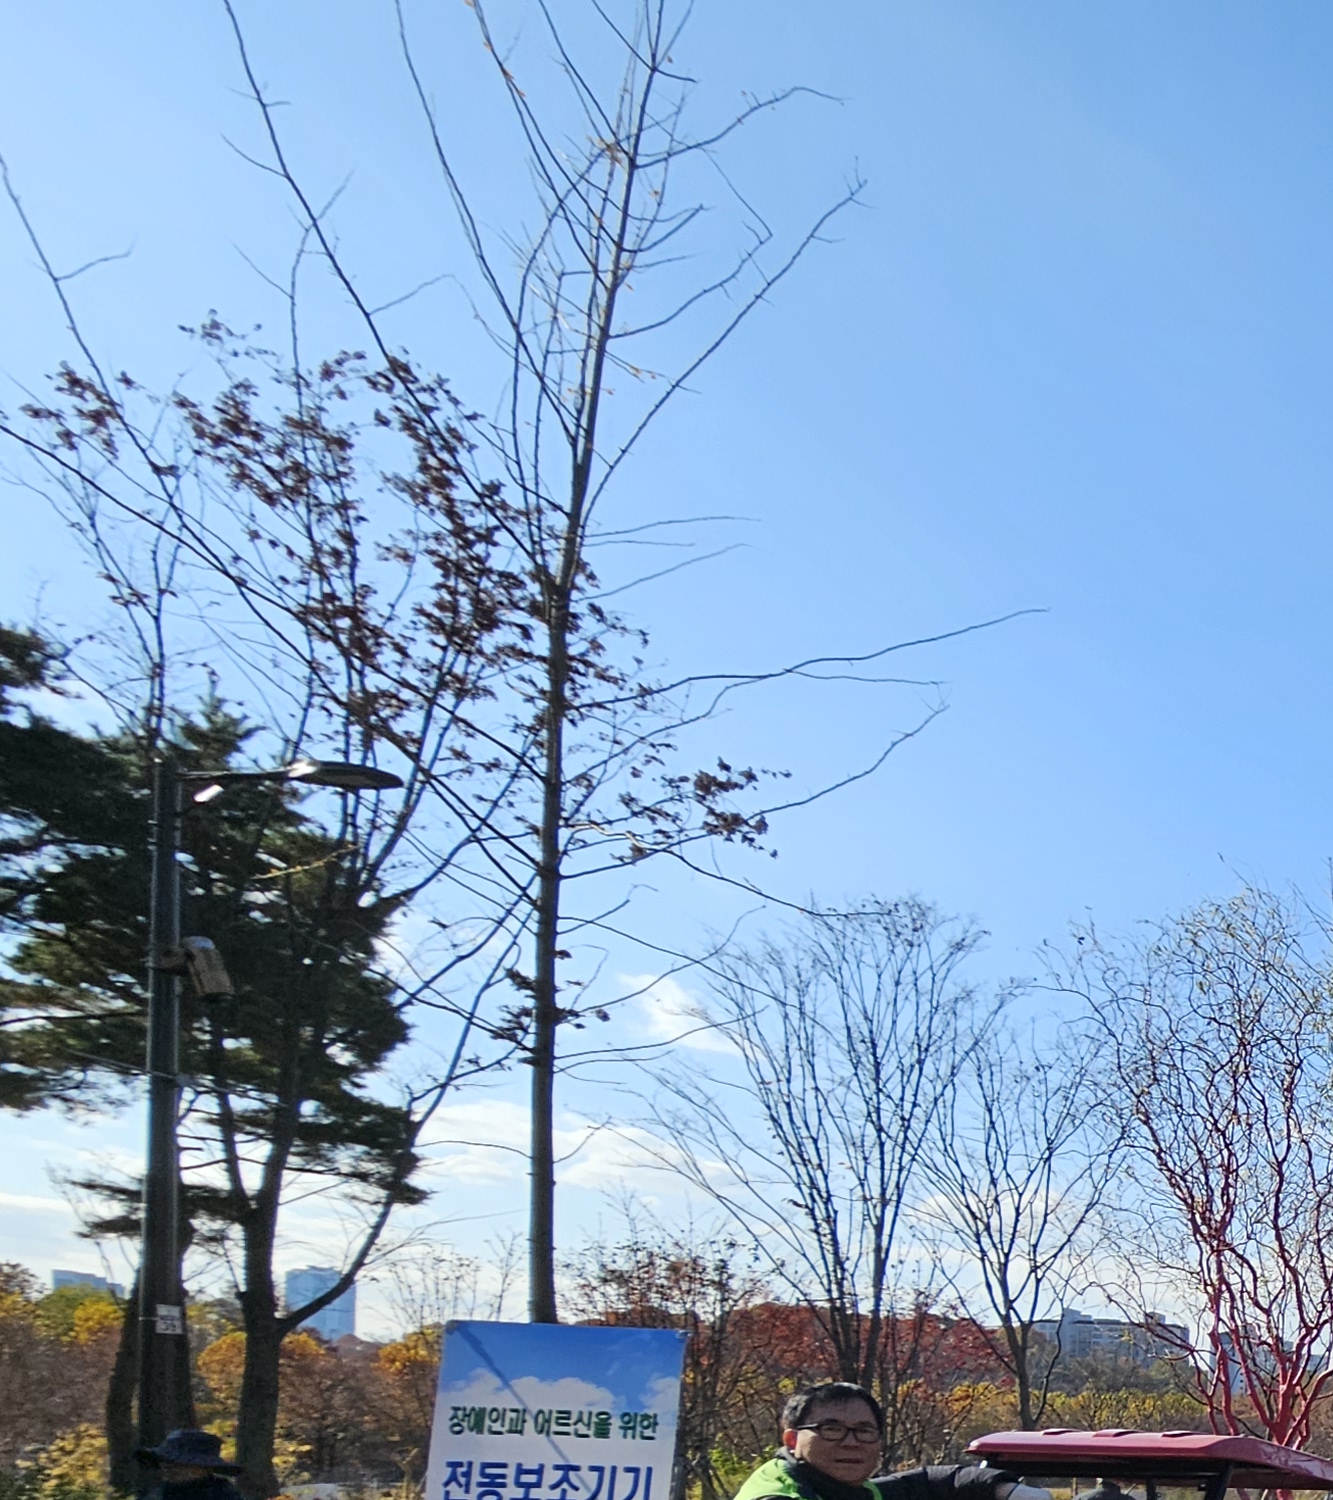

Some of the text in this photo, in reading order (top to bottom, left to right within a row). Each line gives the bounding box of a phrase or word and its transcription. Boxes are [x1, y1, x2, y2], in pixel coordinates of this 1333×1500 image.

[448, 1405, 660, 1441] 장애인과 어르신을 위한
